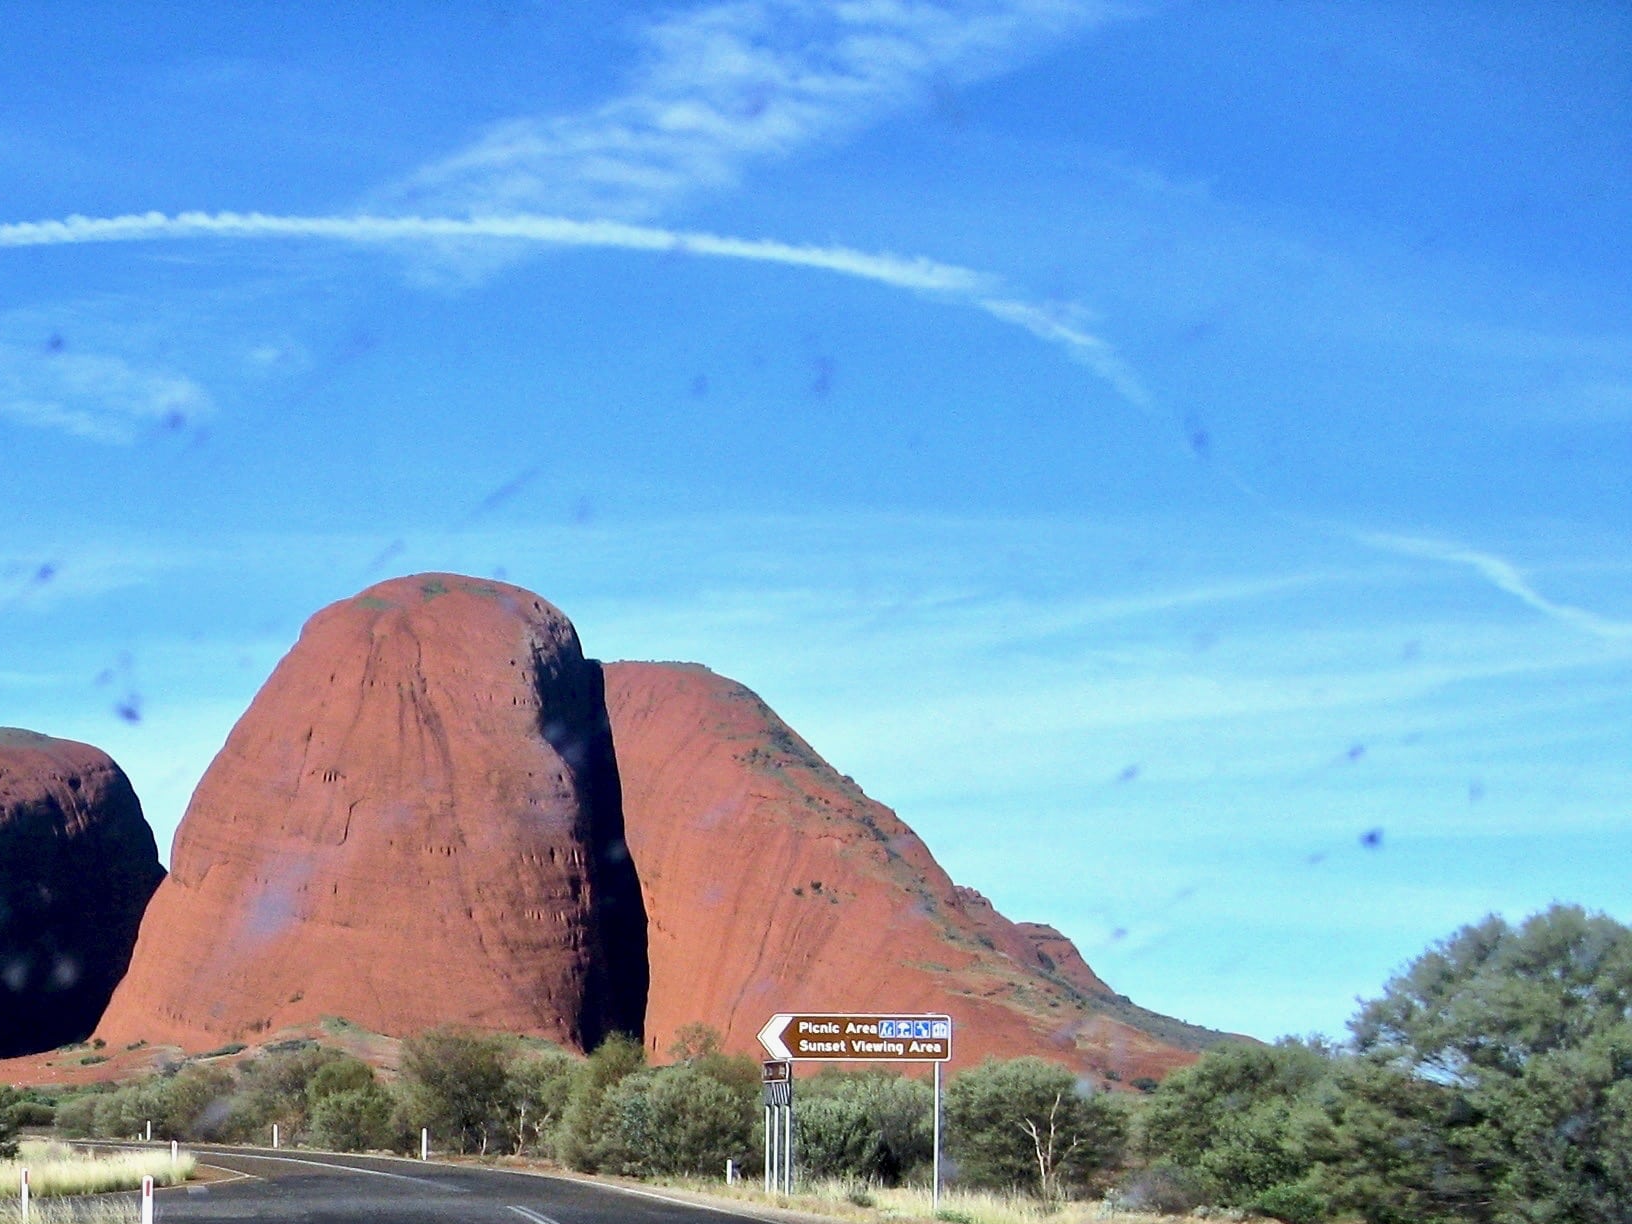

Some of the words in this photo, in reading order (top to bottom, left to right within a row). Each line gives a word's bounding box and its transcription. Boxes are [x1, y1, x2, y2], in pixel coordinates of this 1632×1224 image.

[799, 1022, 840, 1034] Picnic
[845, 1022, 877, 1034] Area
[799, 1040, 846, 1052] Sunset
[852, 1040, 904, 1055] Viewing
[909, 1040, 941, 1052] Area
